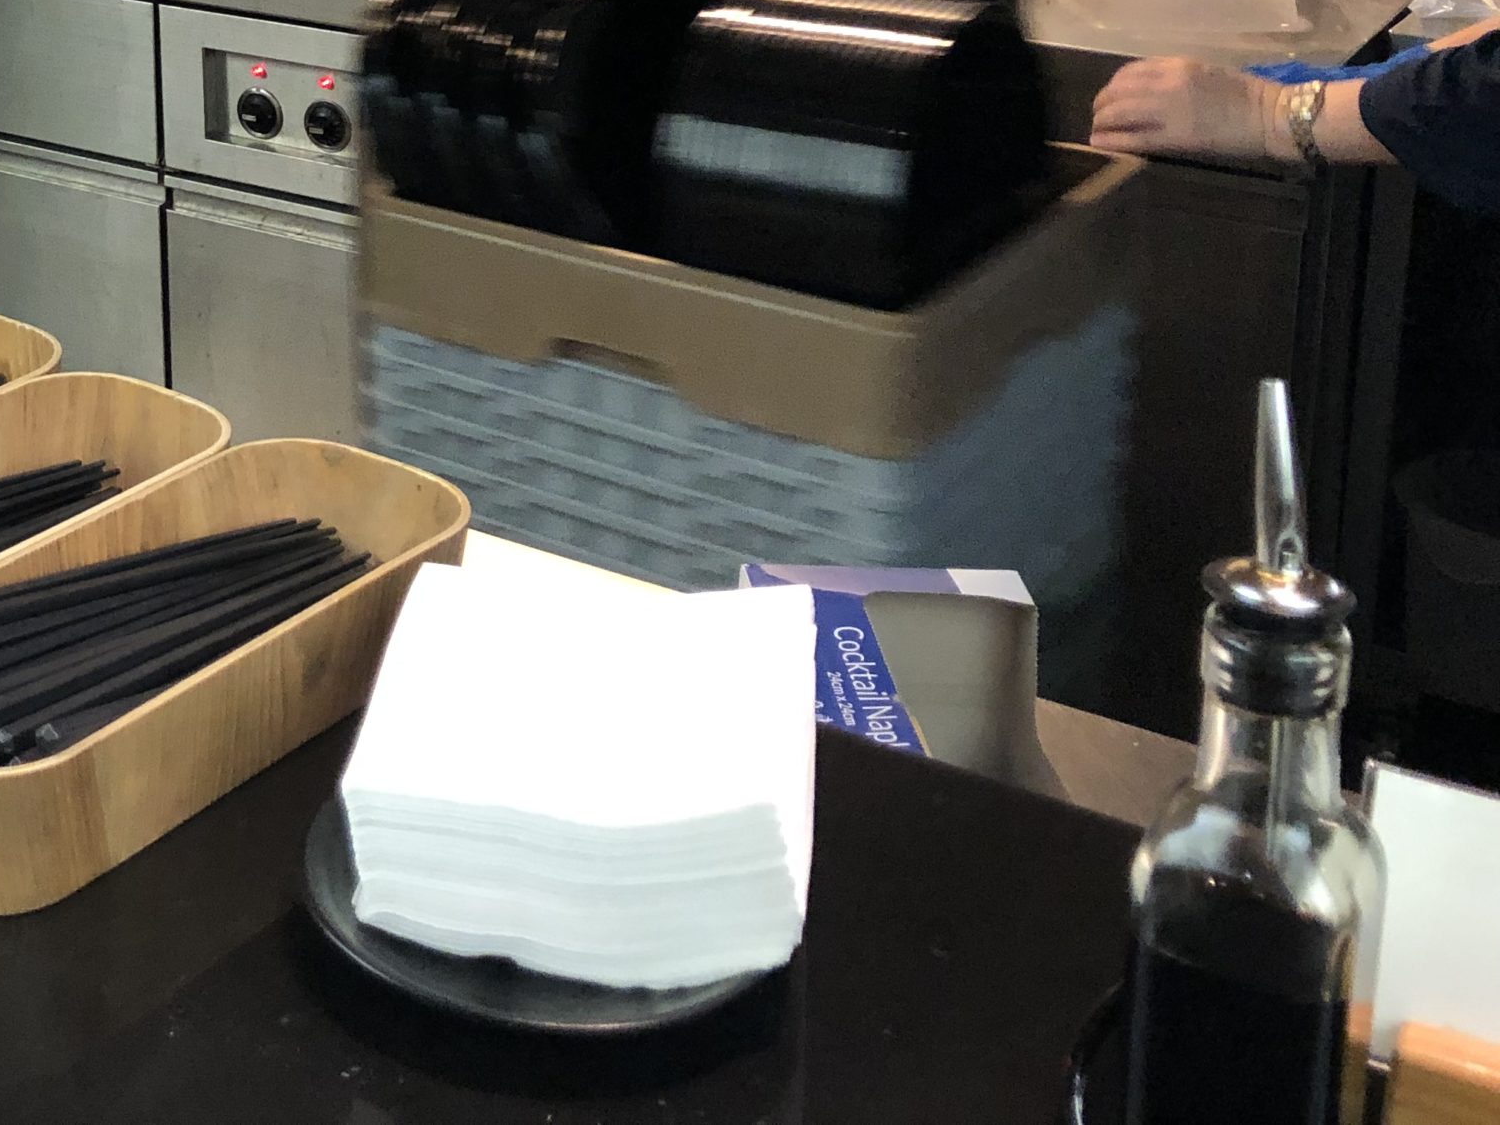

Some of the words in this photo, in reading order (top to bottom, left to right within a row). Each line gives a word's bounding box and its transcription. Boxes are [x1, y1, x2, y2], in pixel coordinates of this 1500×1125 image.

[826, 671, 845, 695] 24cm
[838, 702, 856, 726] 24cm
[833, 626, 890, 701] Cocktail
[862, 705, 911, 747] Nap
